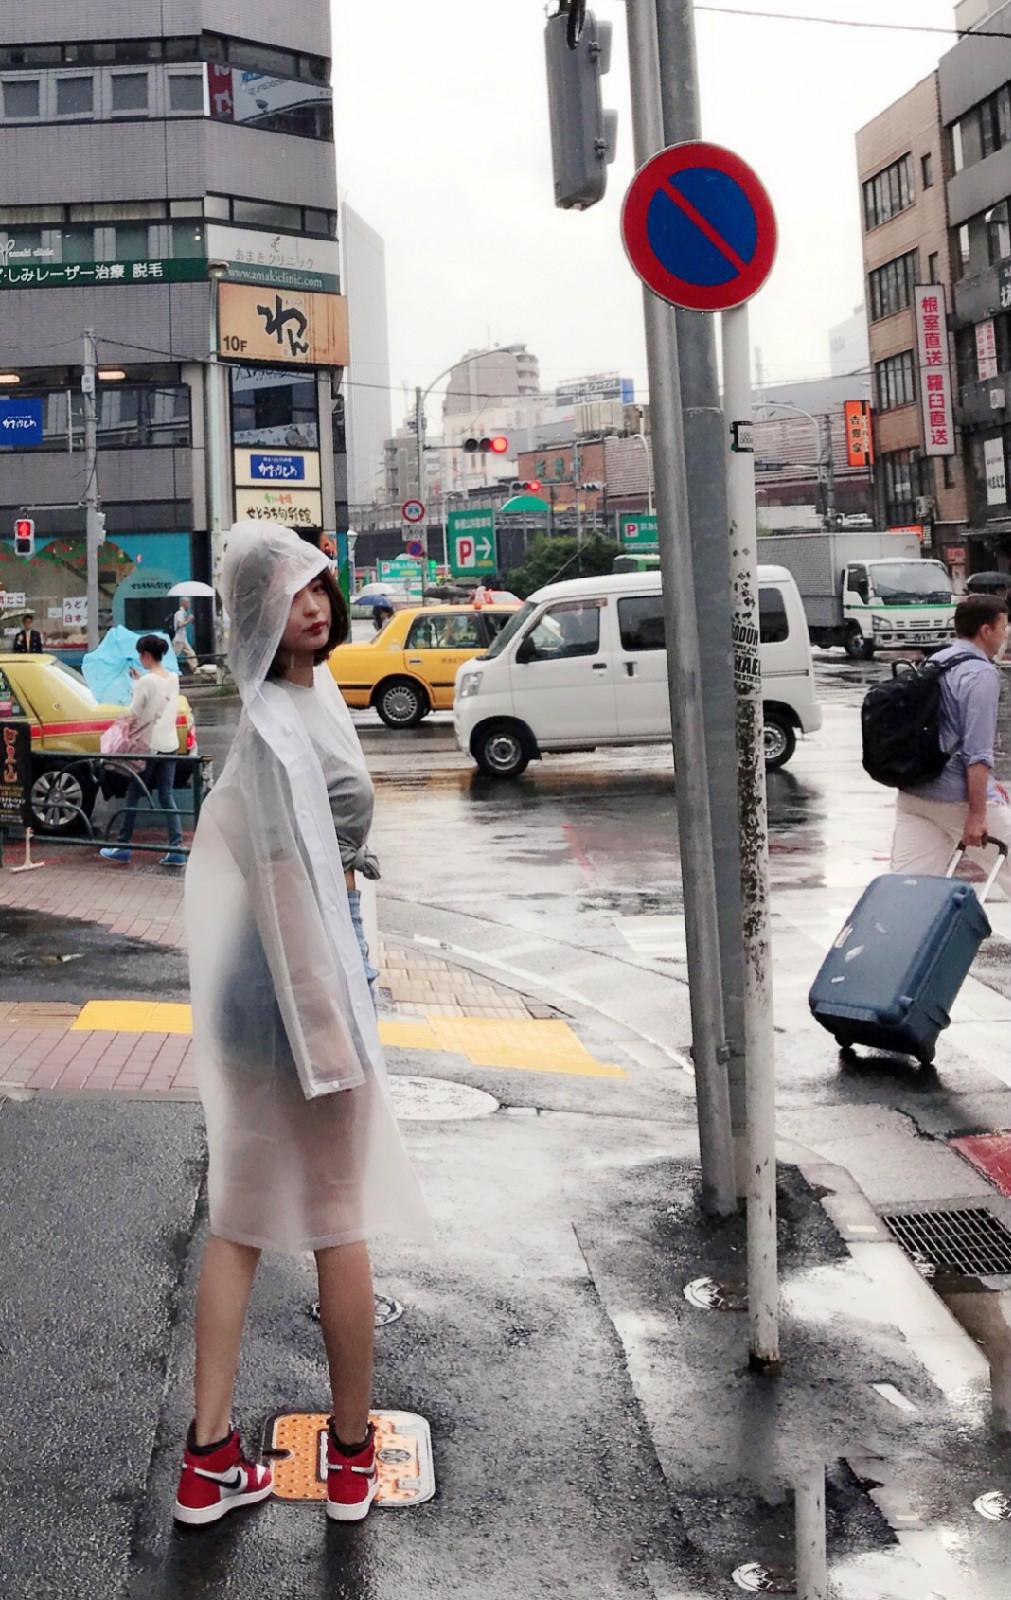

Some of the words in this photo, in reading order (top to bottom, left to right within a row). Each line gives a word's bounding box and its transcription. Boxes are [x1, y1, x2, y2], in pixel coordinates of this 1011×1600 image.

[132, 262, 164, 278] 脱毛
[228, 266, 322, 288] www.amakiclinic.com
[922, 297, 943, 366] 根室直送
[223, 335, 247, 352] 10F
[927, 374, 949, 445] 羅臼直送
[628, 525, 636, 536] P
[459, 541, 472, 565] P
